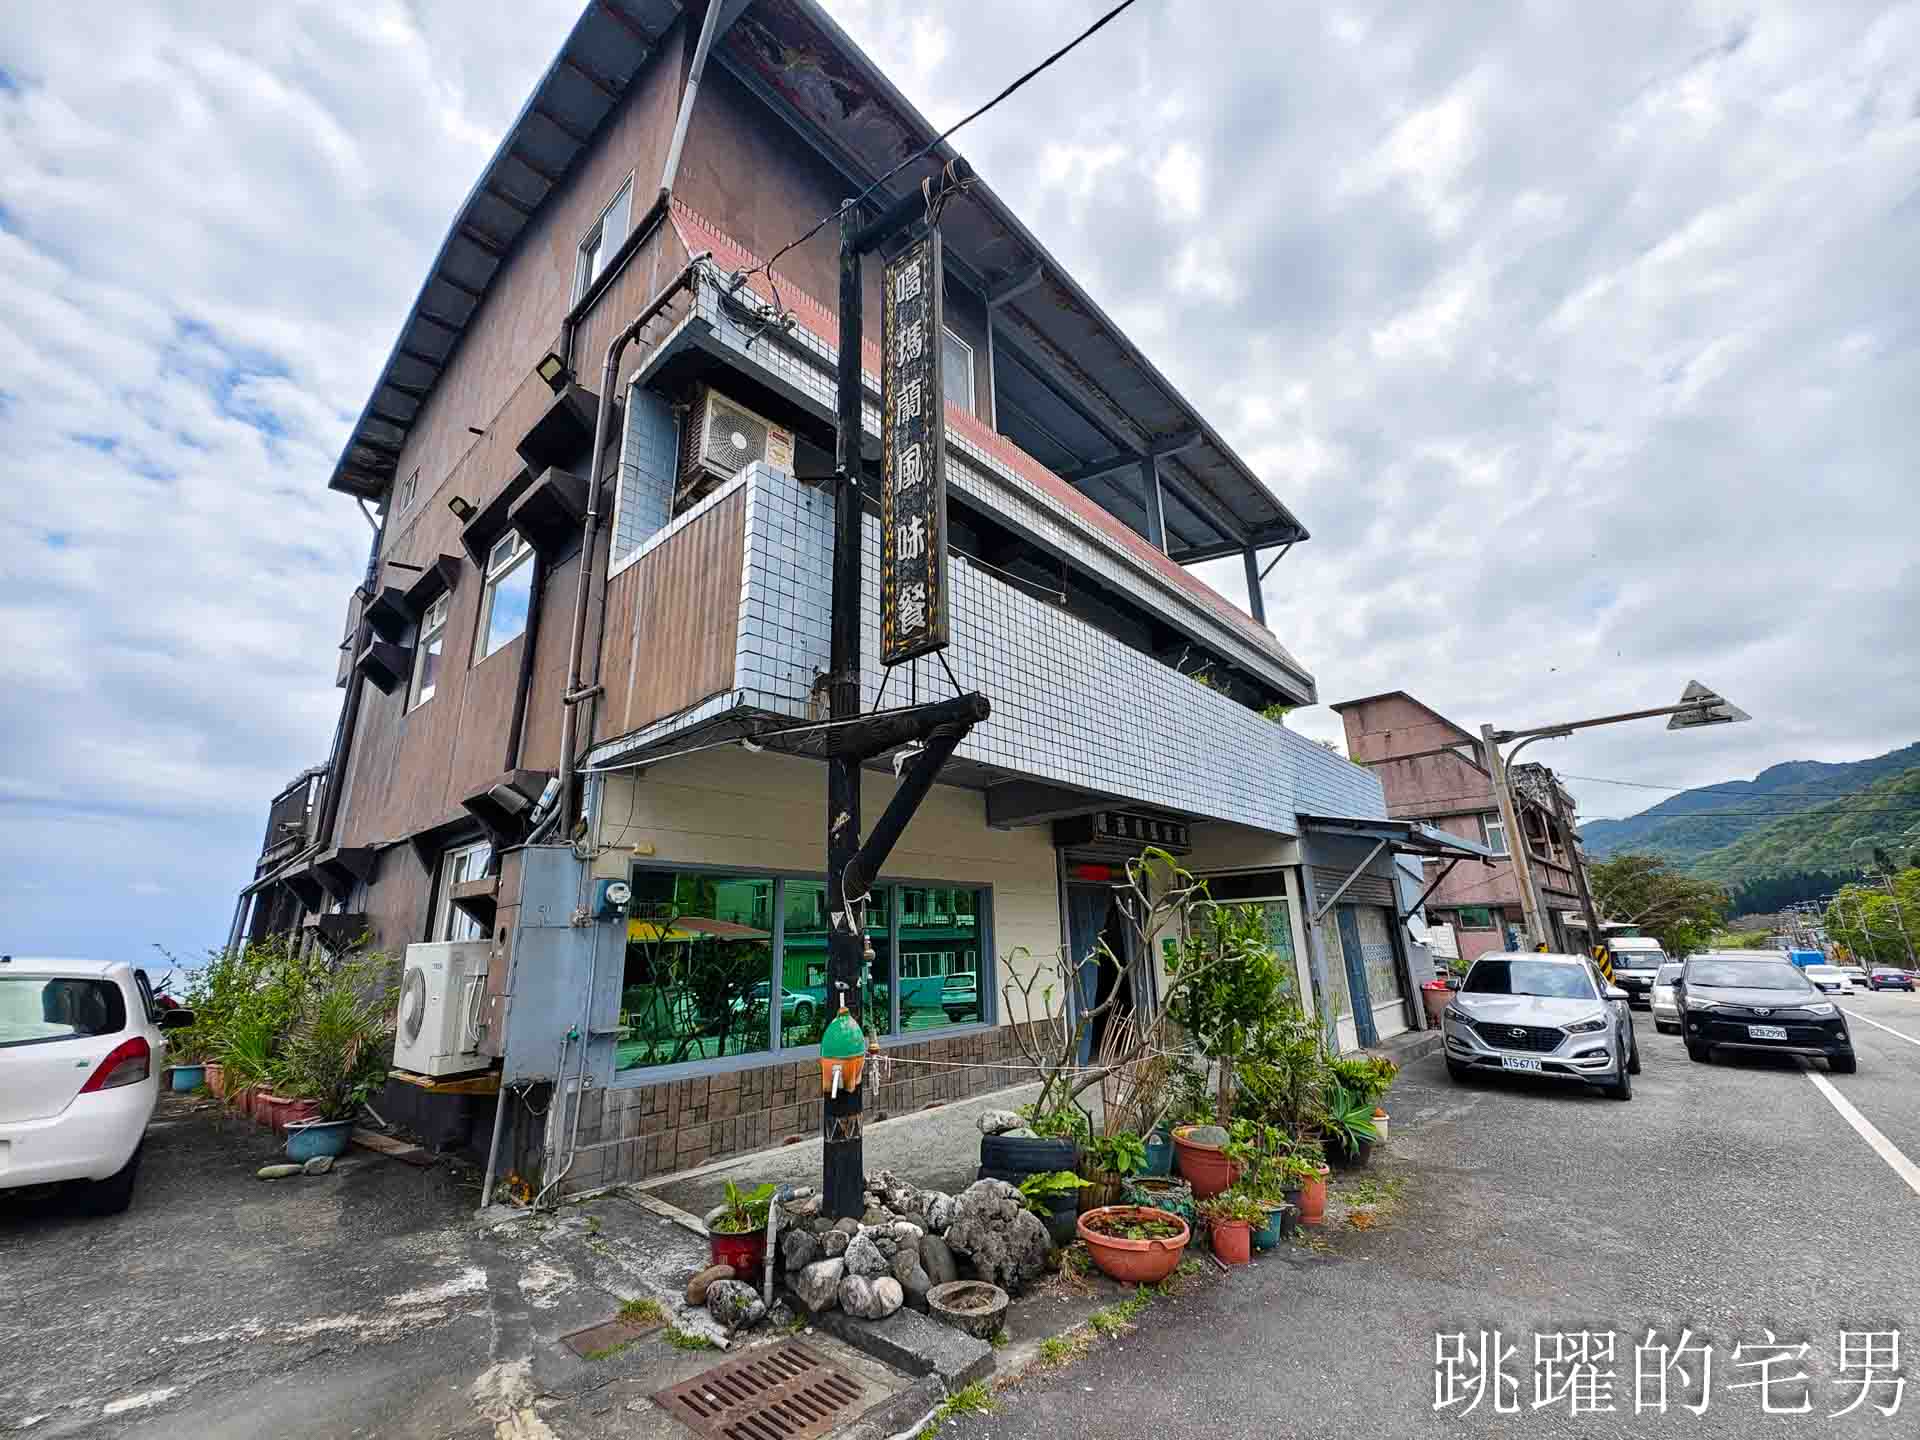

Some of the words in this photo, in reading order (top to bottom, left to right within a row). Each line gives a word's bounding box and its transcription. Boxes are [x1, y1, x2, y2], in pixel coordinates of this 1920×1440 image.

[896, 259, 926, 636] 噶瑪蘭風味餐
